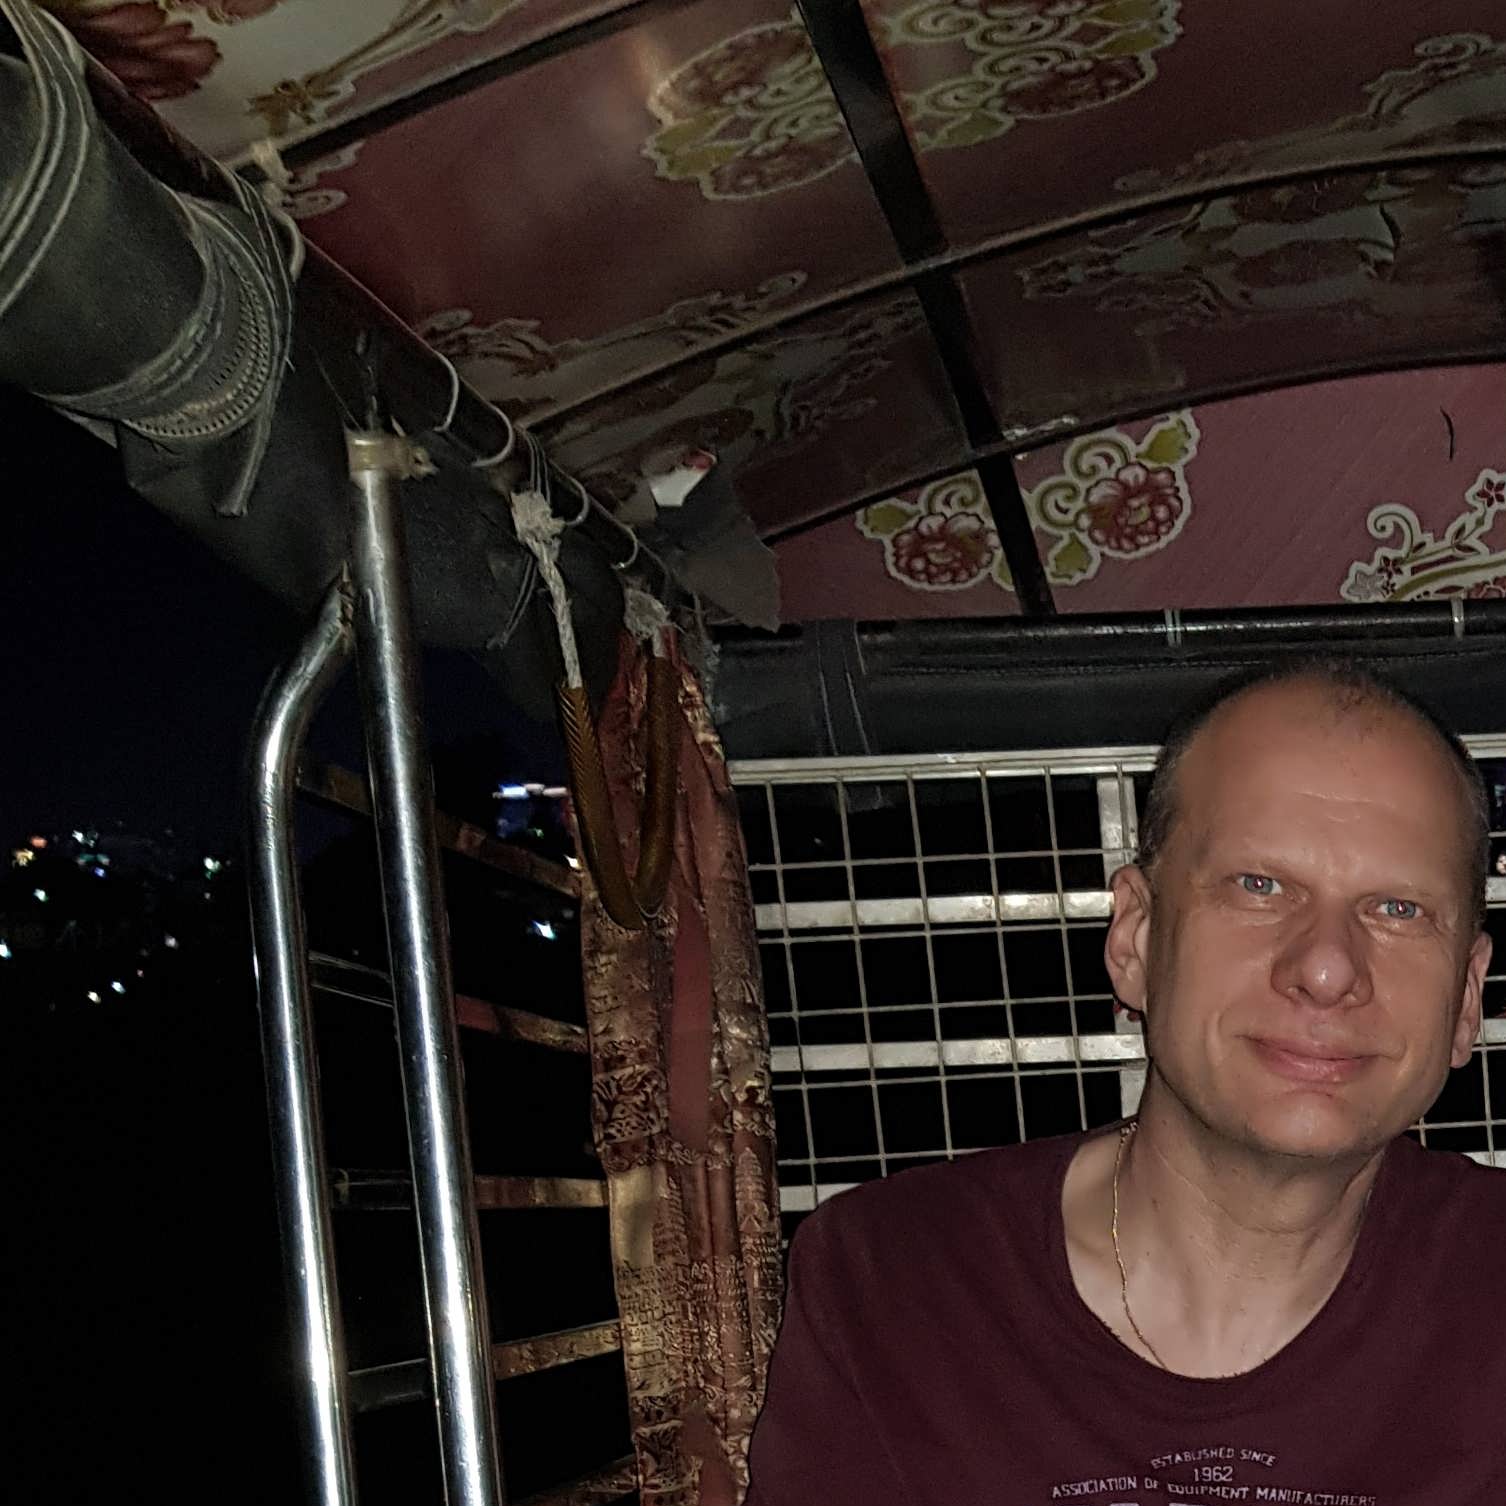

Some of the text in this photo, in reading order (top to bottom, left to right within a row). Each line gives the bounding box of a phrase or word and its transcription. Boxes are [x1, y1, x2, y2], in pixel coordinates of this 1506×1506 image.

[1239, 1448, 1277, 1467] SINCE
[1193, 1465, 1233, 1483] 1962
[1051, 1476, 1138, 1499] ASSOCIATION
